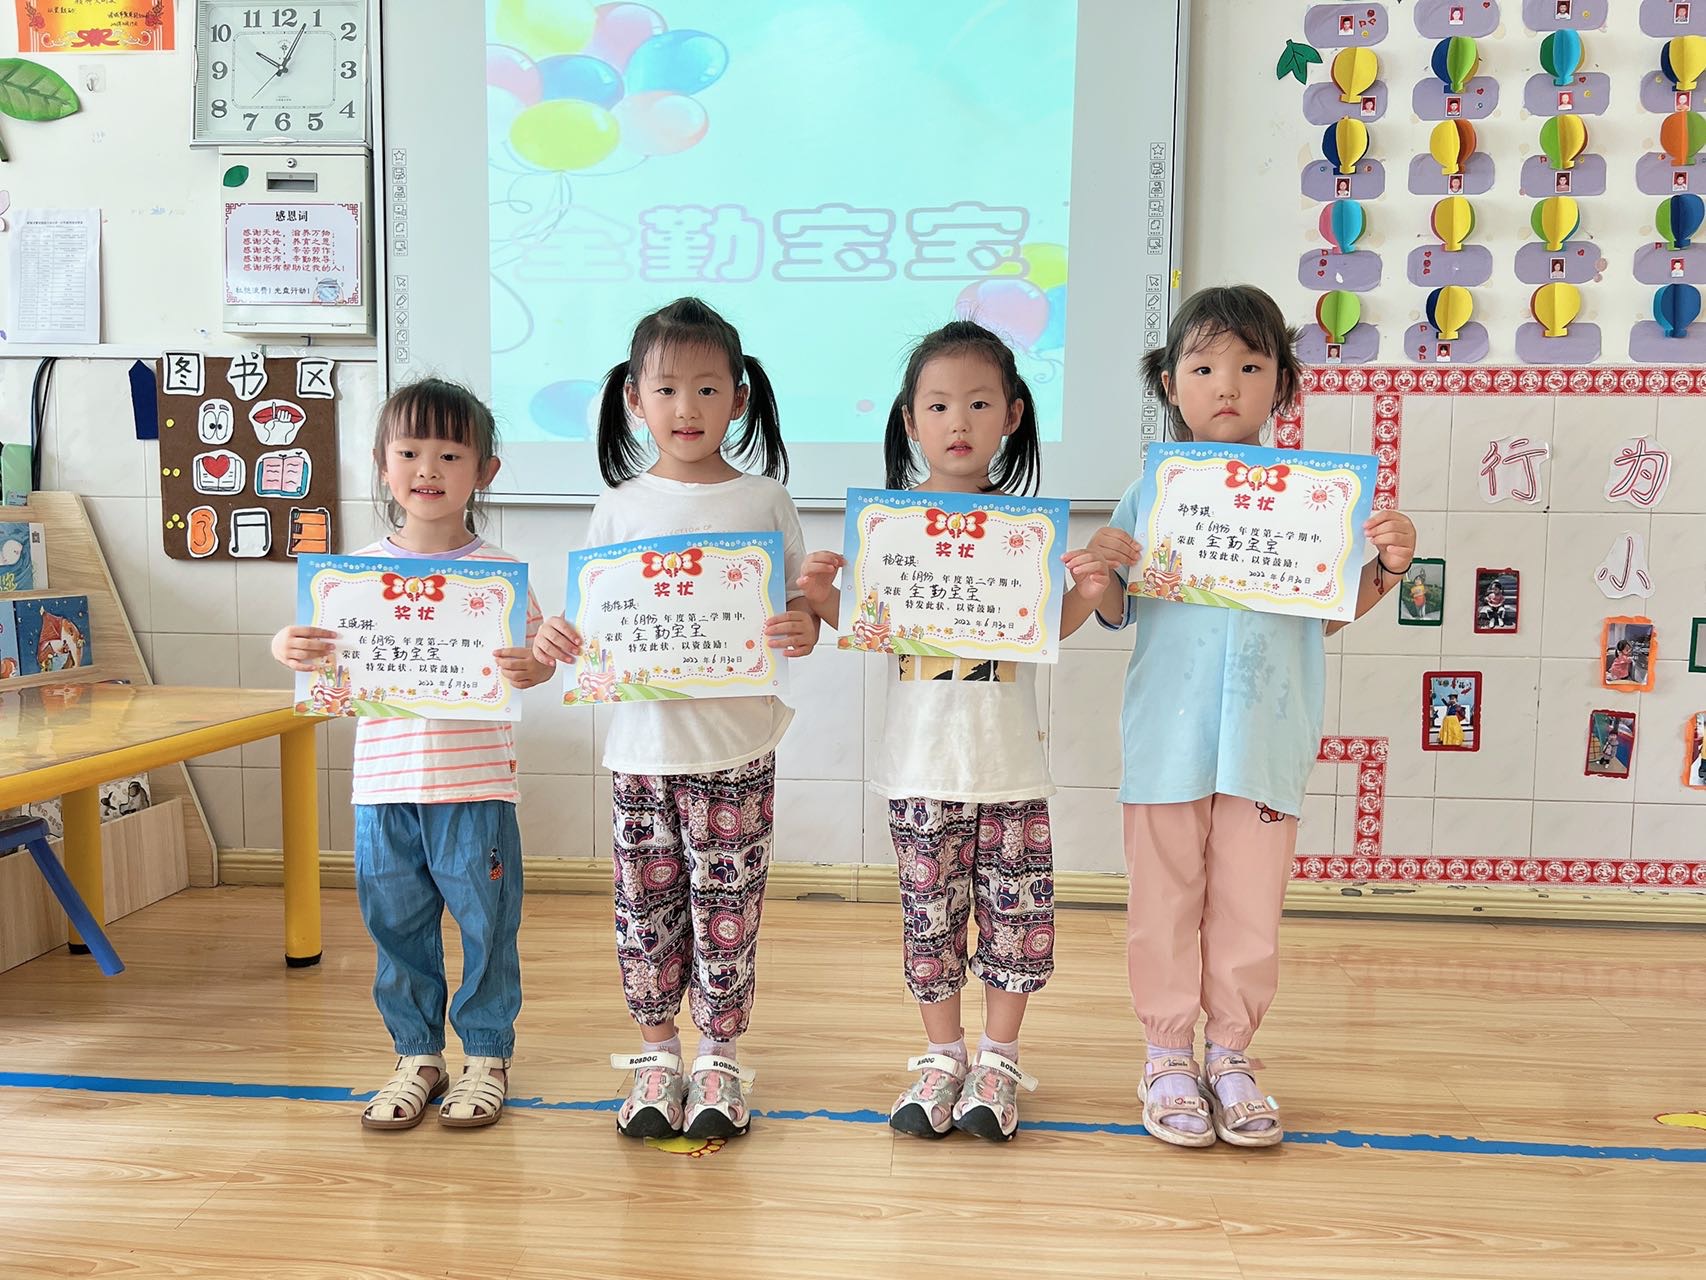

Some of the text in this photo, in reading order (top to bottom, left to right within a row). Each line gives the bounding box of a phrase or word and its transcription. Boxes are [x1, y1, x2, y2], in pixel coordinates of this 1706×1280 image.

[243, 9, 262, 28] 11
[272, 8, 298, 28] 12
[312, 8, 322, 27] 1
[210, 24, 232, 43] 10
[340, 22, 357, 42] 2
[211, 61, 228, 80] 9
[340, 60, 357, 79] 3
[211, 99, 228, 119] 8
[339, 100, 356, 119] 4
[243, 113, 259, 132] 7
[274, 112, 291, 132] 6
[307, 112, 324, 131] 5
[275, 210, 308, 222] 感恩词
[512, 200, 1030, 283] 全勤宝宝
[165, 351, 332, 398] 图书区
[1233, 493, 1276, 512] 奖状
[935, 541, 975, 559] 奖状
[1597, 536, 1652, 592] 小
[654, 581, 694, 598] 奖状
[394, 605, 435, 621] 奖状
